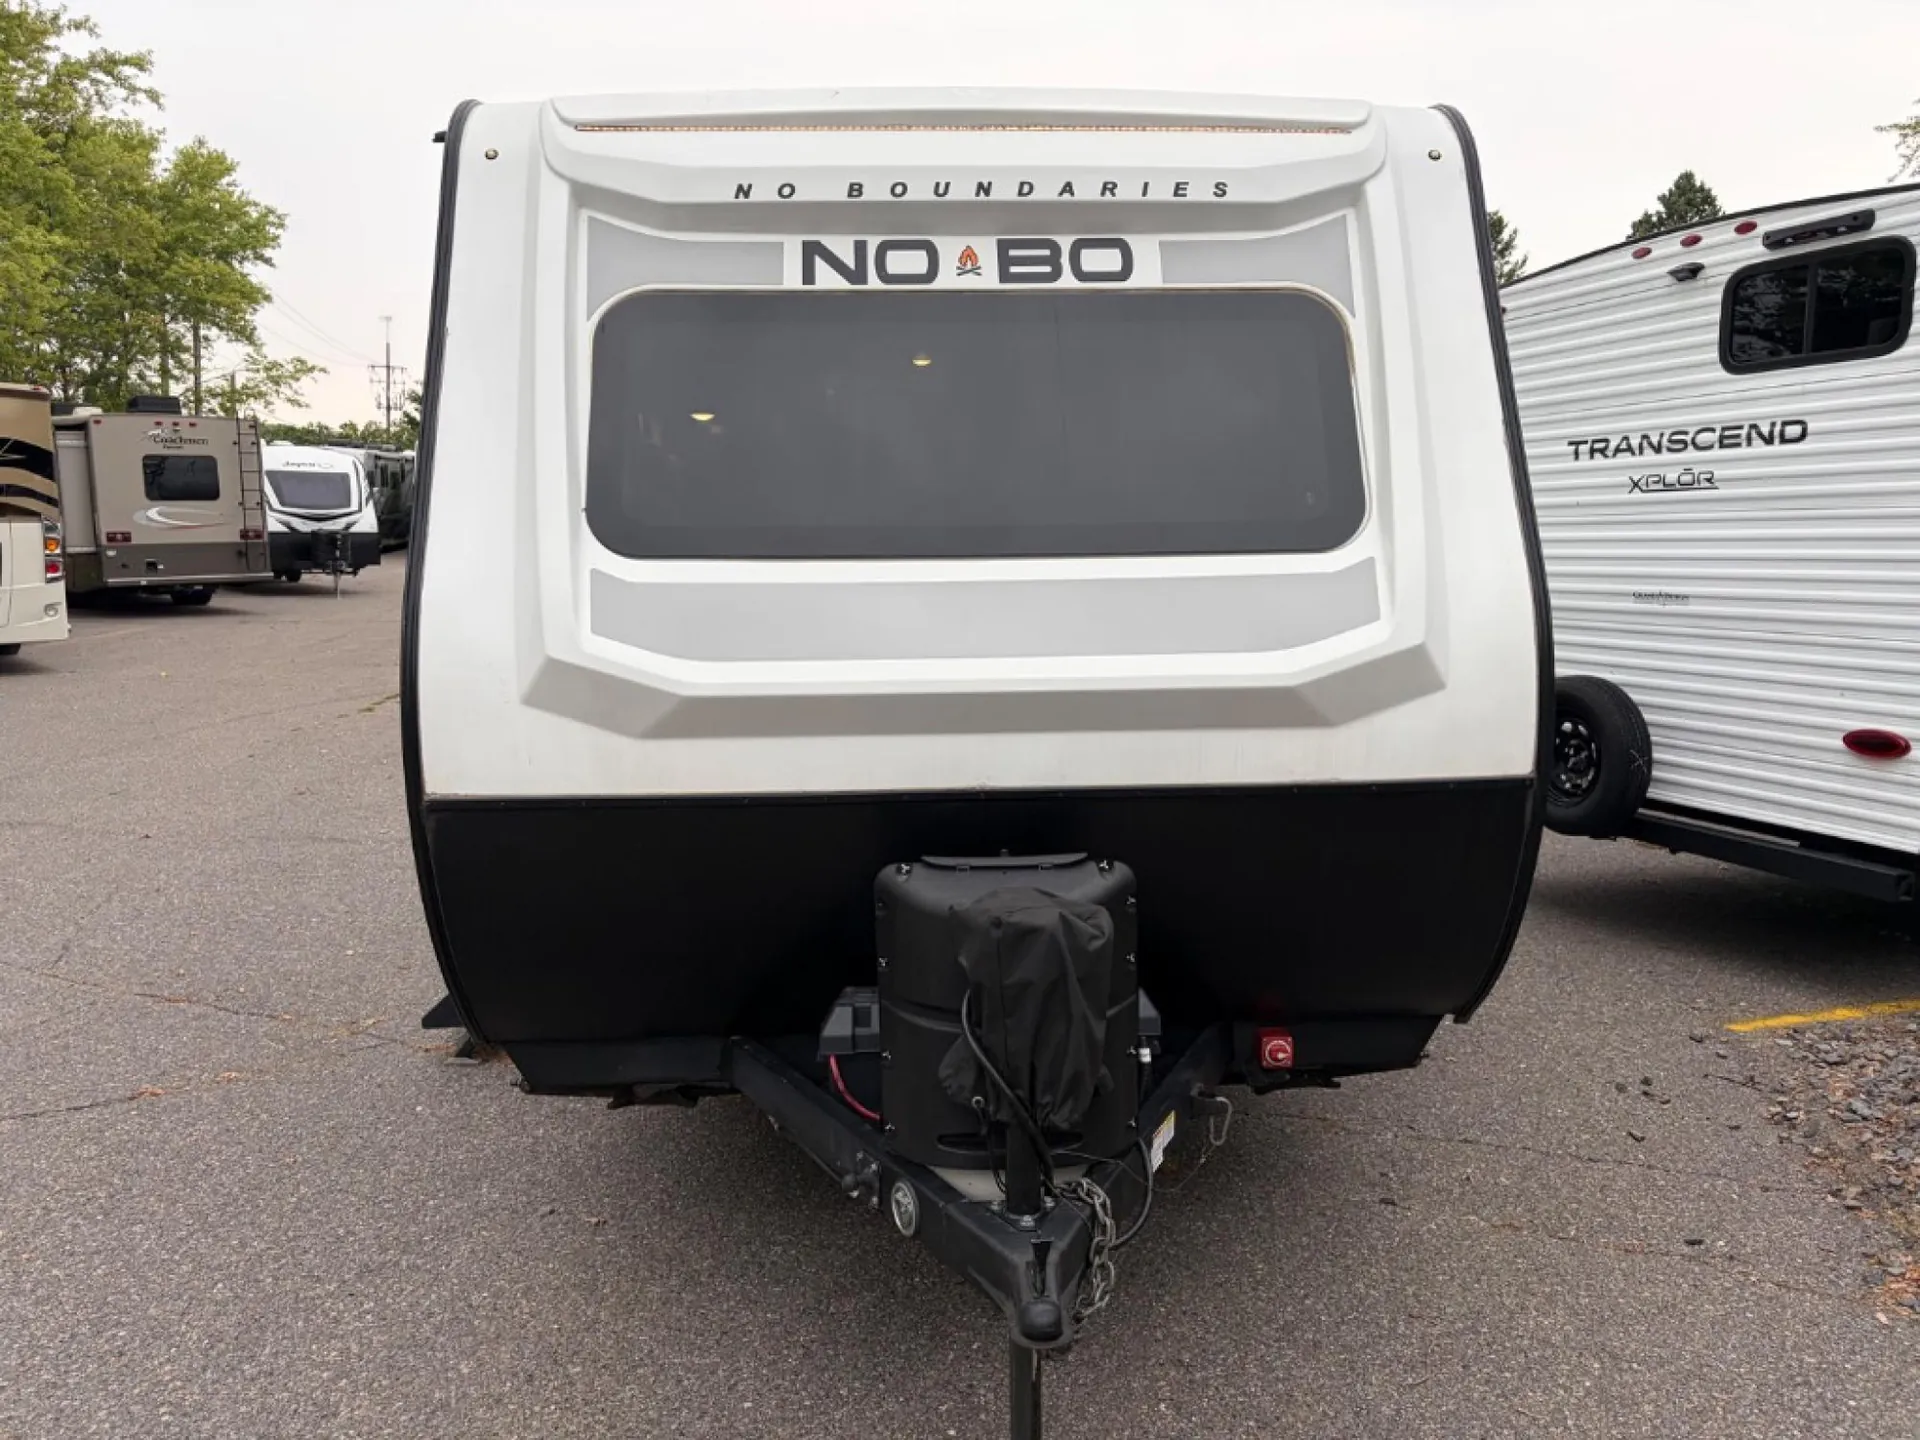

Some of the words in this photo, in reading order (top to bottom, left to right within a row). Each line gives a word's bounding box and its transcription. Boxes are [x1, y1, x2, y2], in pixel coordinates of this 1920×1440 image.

[734, 183, 796, 199] NO
[847, 181, 1228, 198] BOUNDARIES
[802, 239, 940, 285] NO
[996, 237, 1134, 283] BO
[1567, 419, 1809, 461] TRANSCEND
